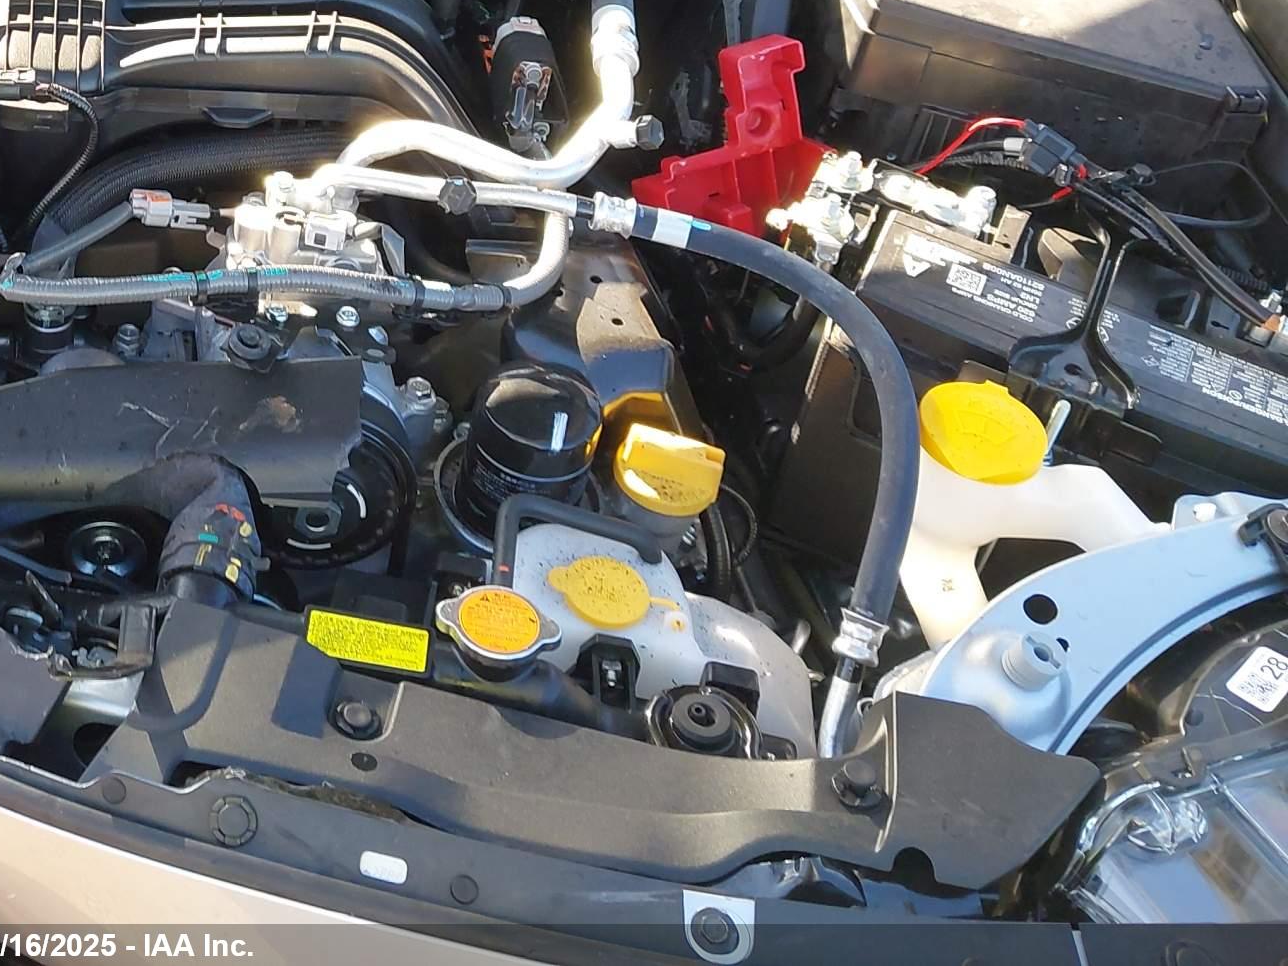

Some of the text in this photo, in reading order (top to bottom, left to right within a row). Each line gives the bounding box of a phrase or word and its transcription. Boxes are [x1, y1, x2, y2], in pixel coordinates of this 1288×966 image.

[986, 293, 1017, 309] AMPS
[1010, 296, 1038, 309] GROUP
[1011, 310, 1034, 322] COLD
[1260, 656, 1288, 680] 28
